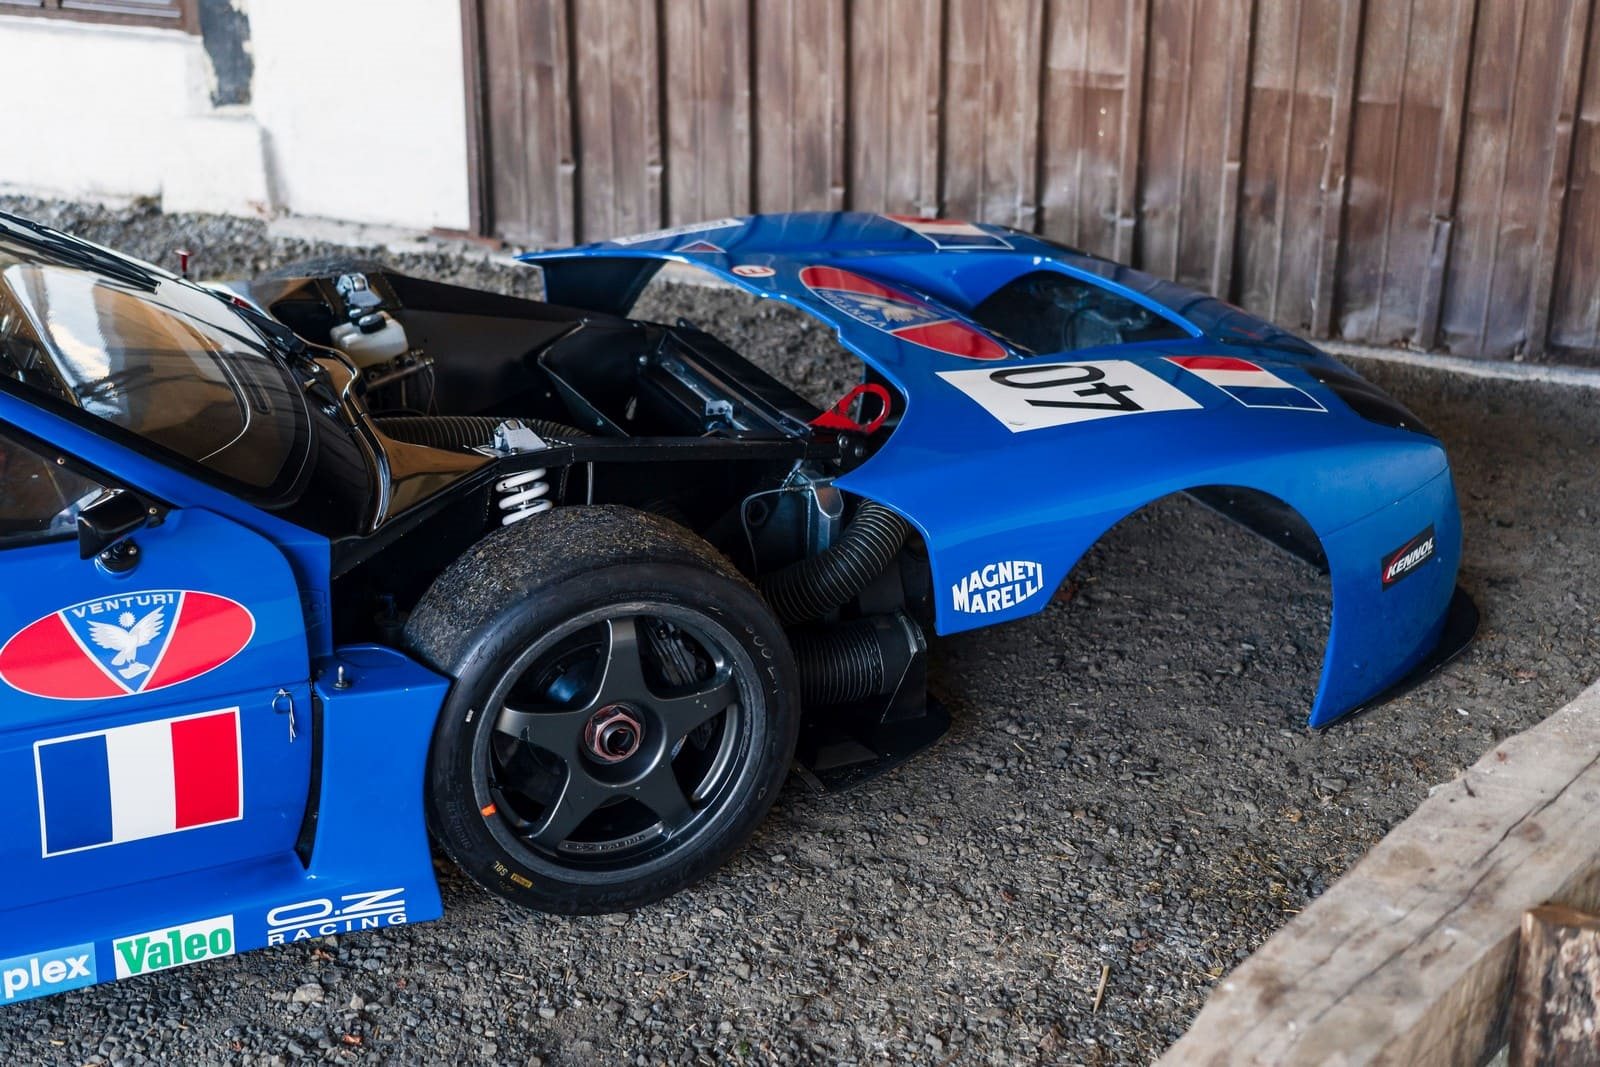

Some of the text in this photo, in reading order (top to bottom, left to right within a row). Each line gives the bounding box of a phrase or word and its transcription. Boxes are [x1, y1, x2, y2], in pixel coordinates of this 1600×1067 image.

[989, 365, 1145, 412] 40
[1386, 537, 1434, 580] KENNOL
[72, 593, 174, 618] VENTURI
[952, 560, 1044, 606] MAGNETI
[952, 568, 1044, 613] MARELLI
[116, 927, 232, 975] Valeo
[267, 913, 407, 947] RACING
[0, 954, 92, 999] plex
